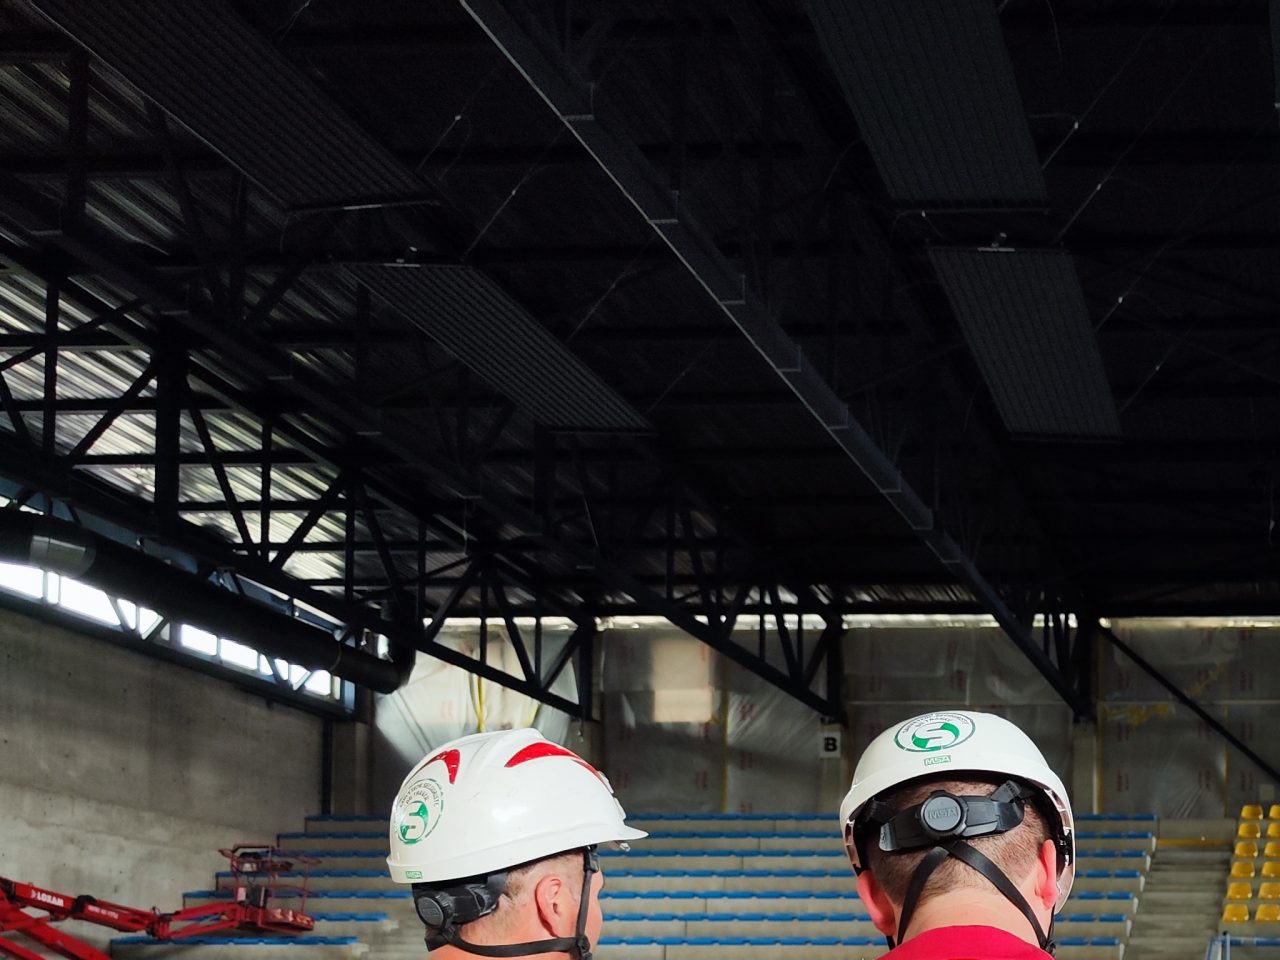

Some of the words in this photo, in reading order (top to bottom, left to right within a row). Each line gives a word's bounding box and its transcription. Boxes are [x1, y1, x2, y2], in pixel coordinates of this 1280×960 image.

[824, 736, 838, 752] B
[925, 755, 951, 765] MSA
[929, 807, 957, 820] MSA
